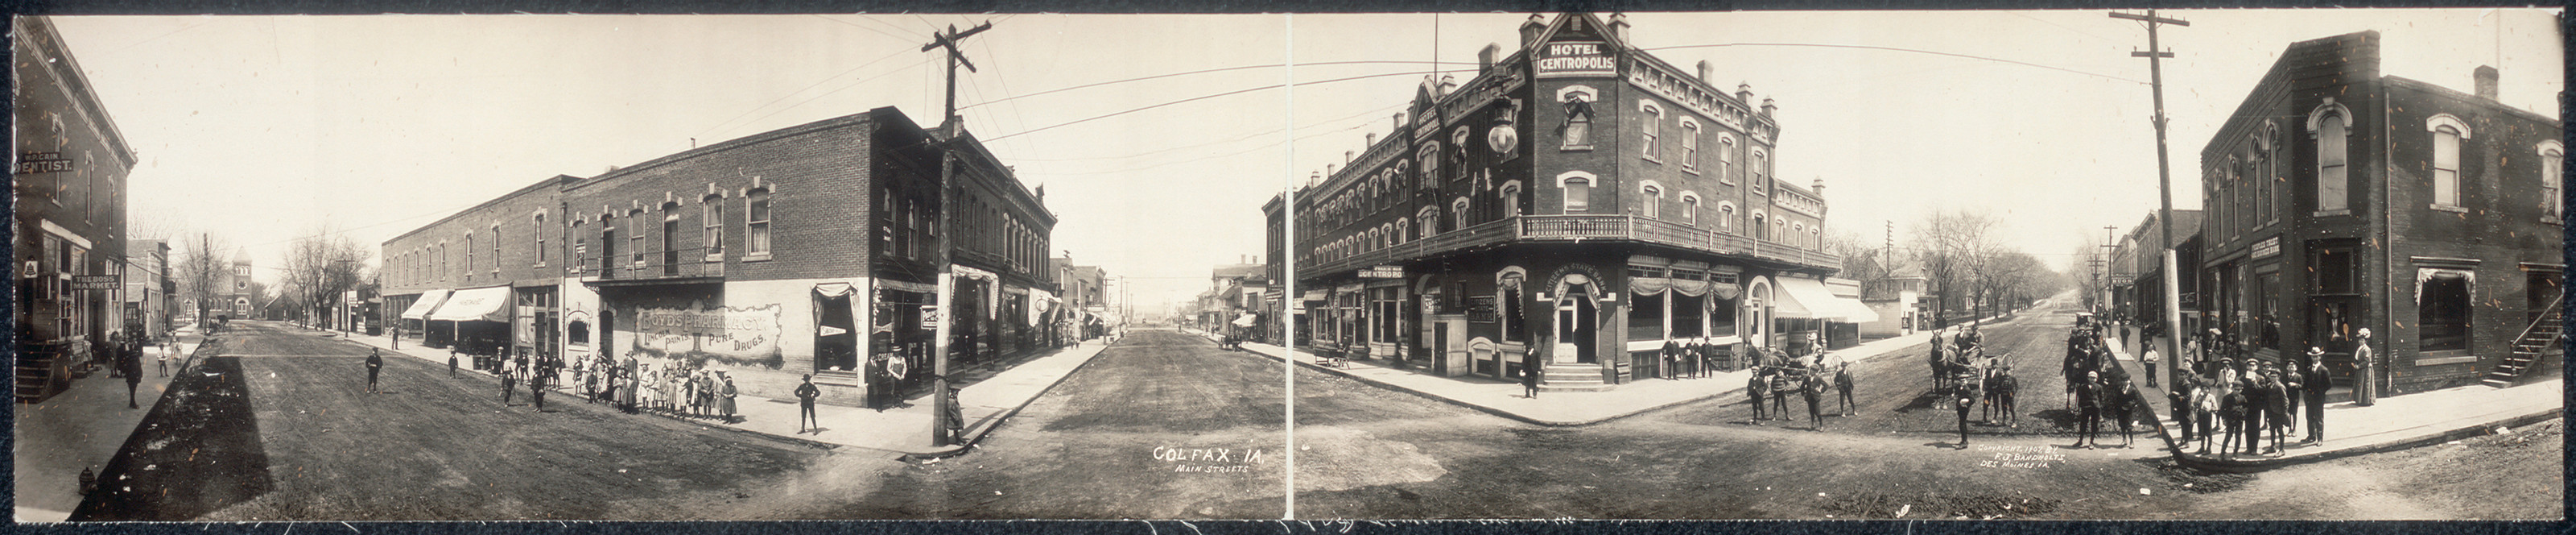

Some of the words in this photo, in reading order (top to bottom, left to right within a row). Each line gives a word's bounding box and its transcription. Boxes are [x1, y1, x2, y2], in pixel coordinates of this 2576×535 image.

[1551, 44, 1601, 55] HOTEL
[1540, 57, 1614, 69] CENTROPOLIS
[1418, 108, 1437, 125] HOTEL
[1546, 265, 1570, 292] CITIZENS
[1571, 263, 1594, 273] STATE
[1593, 271, 1607, 292] BANK
[644, 329, 671, 346] LINCOLN
[708, 332, 734, 346] PURE
[733, 334, 767, 351] DRUGS.
